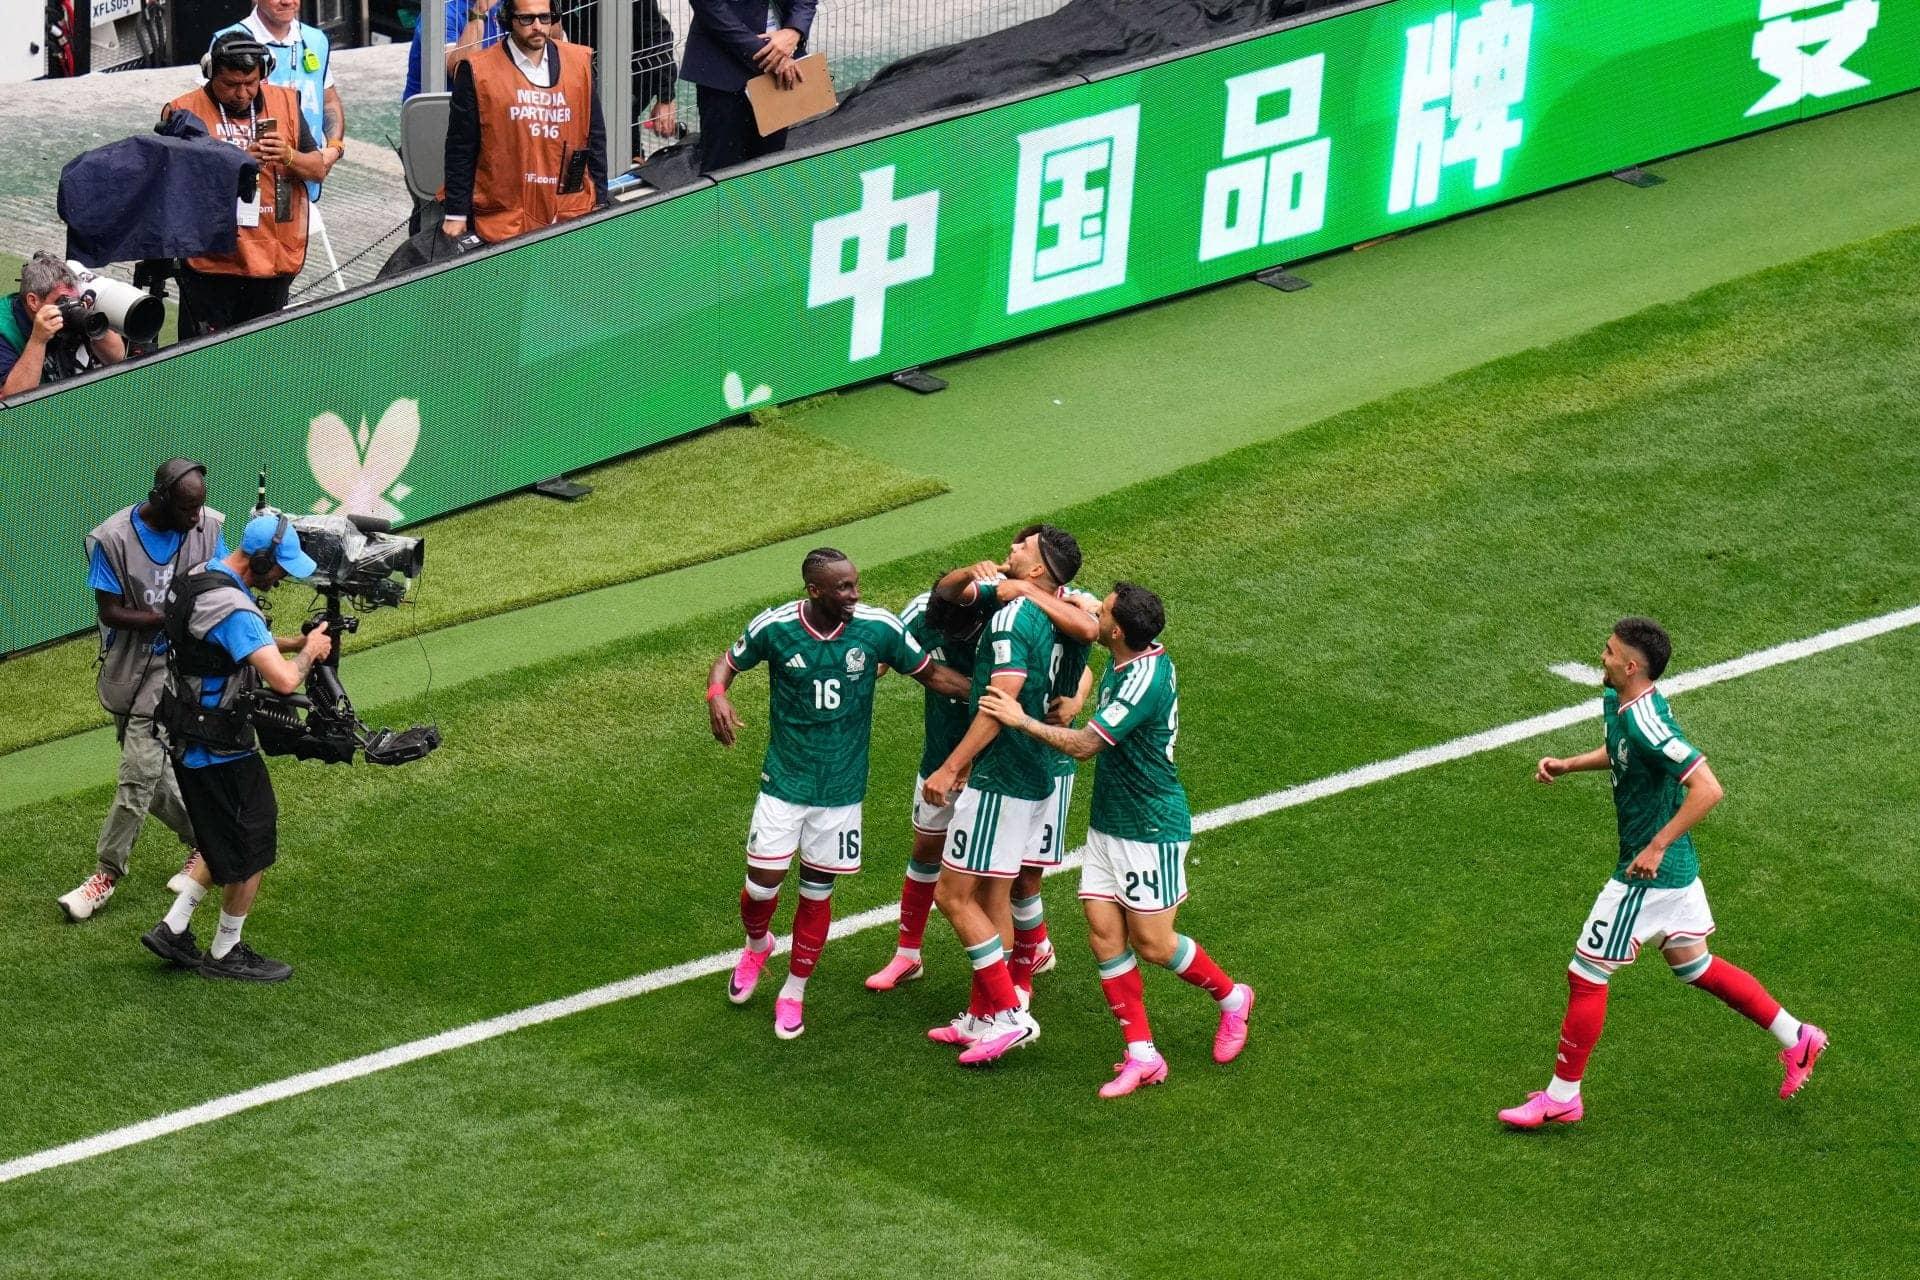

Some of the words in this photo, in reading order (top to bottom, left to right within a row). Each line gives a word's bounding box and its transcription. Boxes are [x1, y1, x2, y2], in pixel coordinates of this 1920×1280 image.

[516, 89, 567, 106] MEDIA
[510, 106, 571, 122] PARTNER
[813, 678, 841, 710] 16
[838, 829, 860, 860] 16
[951, 829, 968, 859] 9
[1040, 823, 1053, 854] 3
[1125, 869, 1159, 902] 24
[1587, 919, 1609, 950] 5
